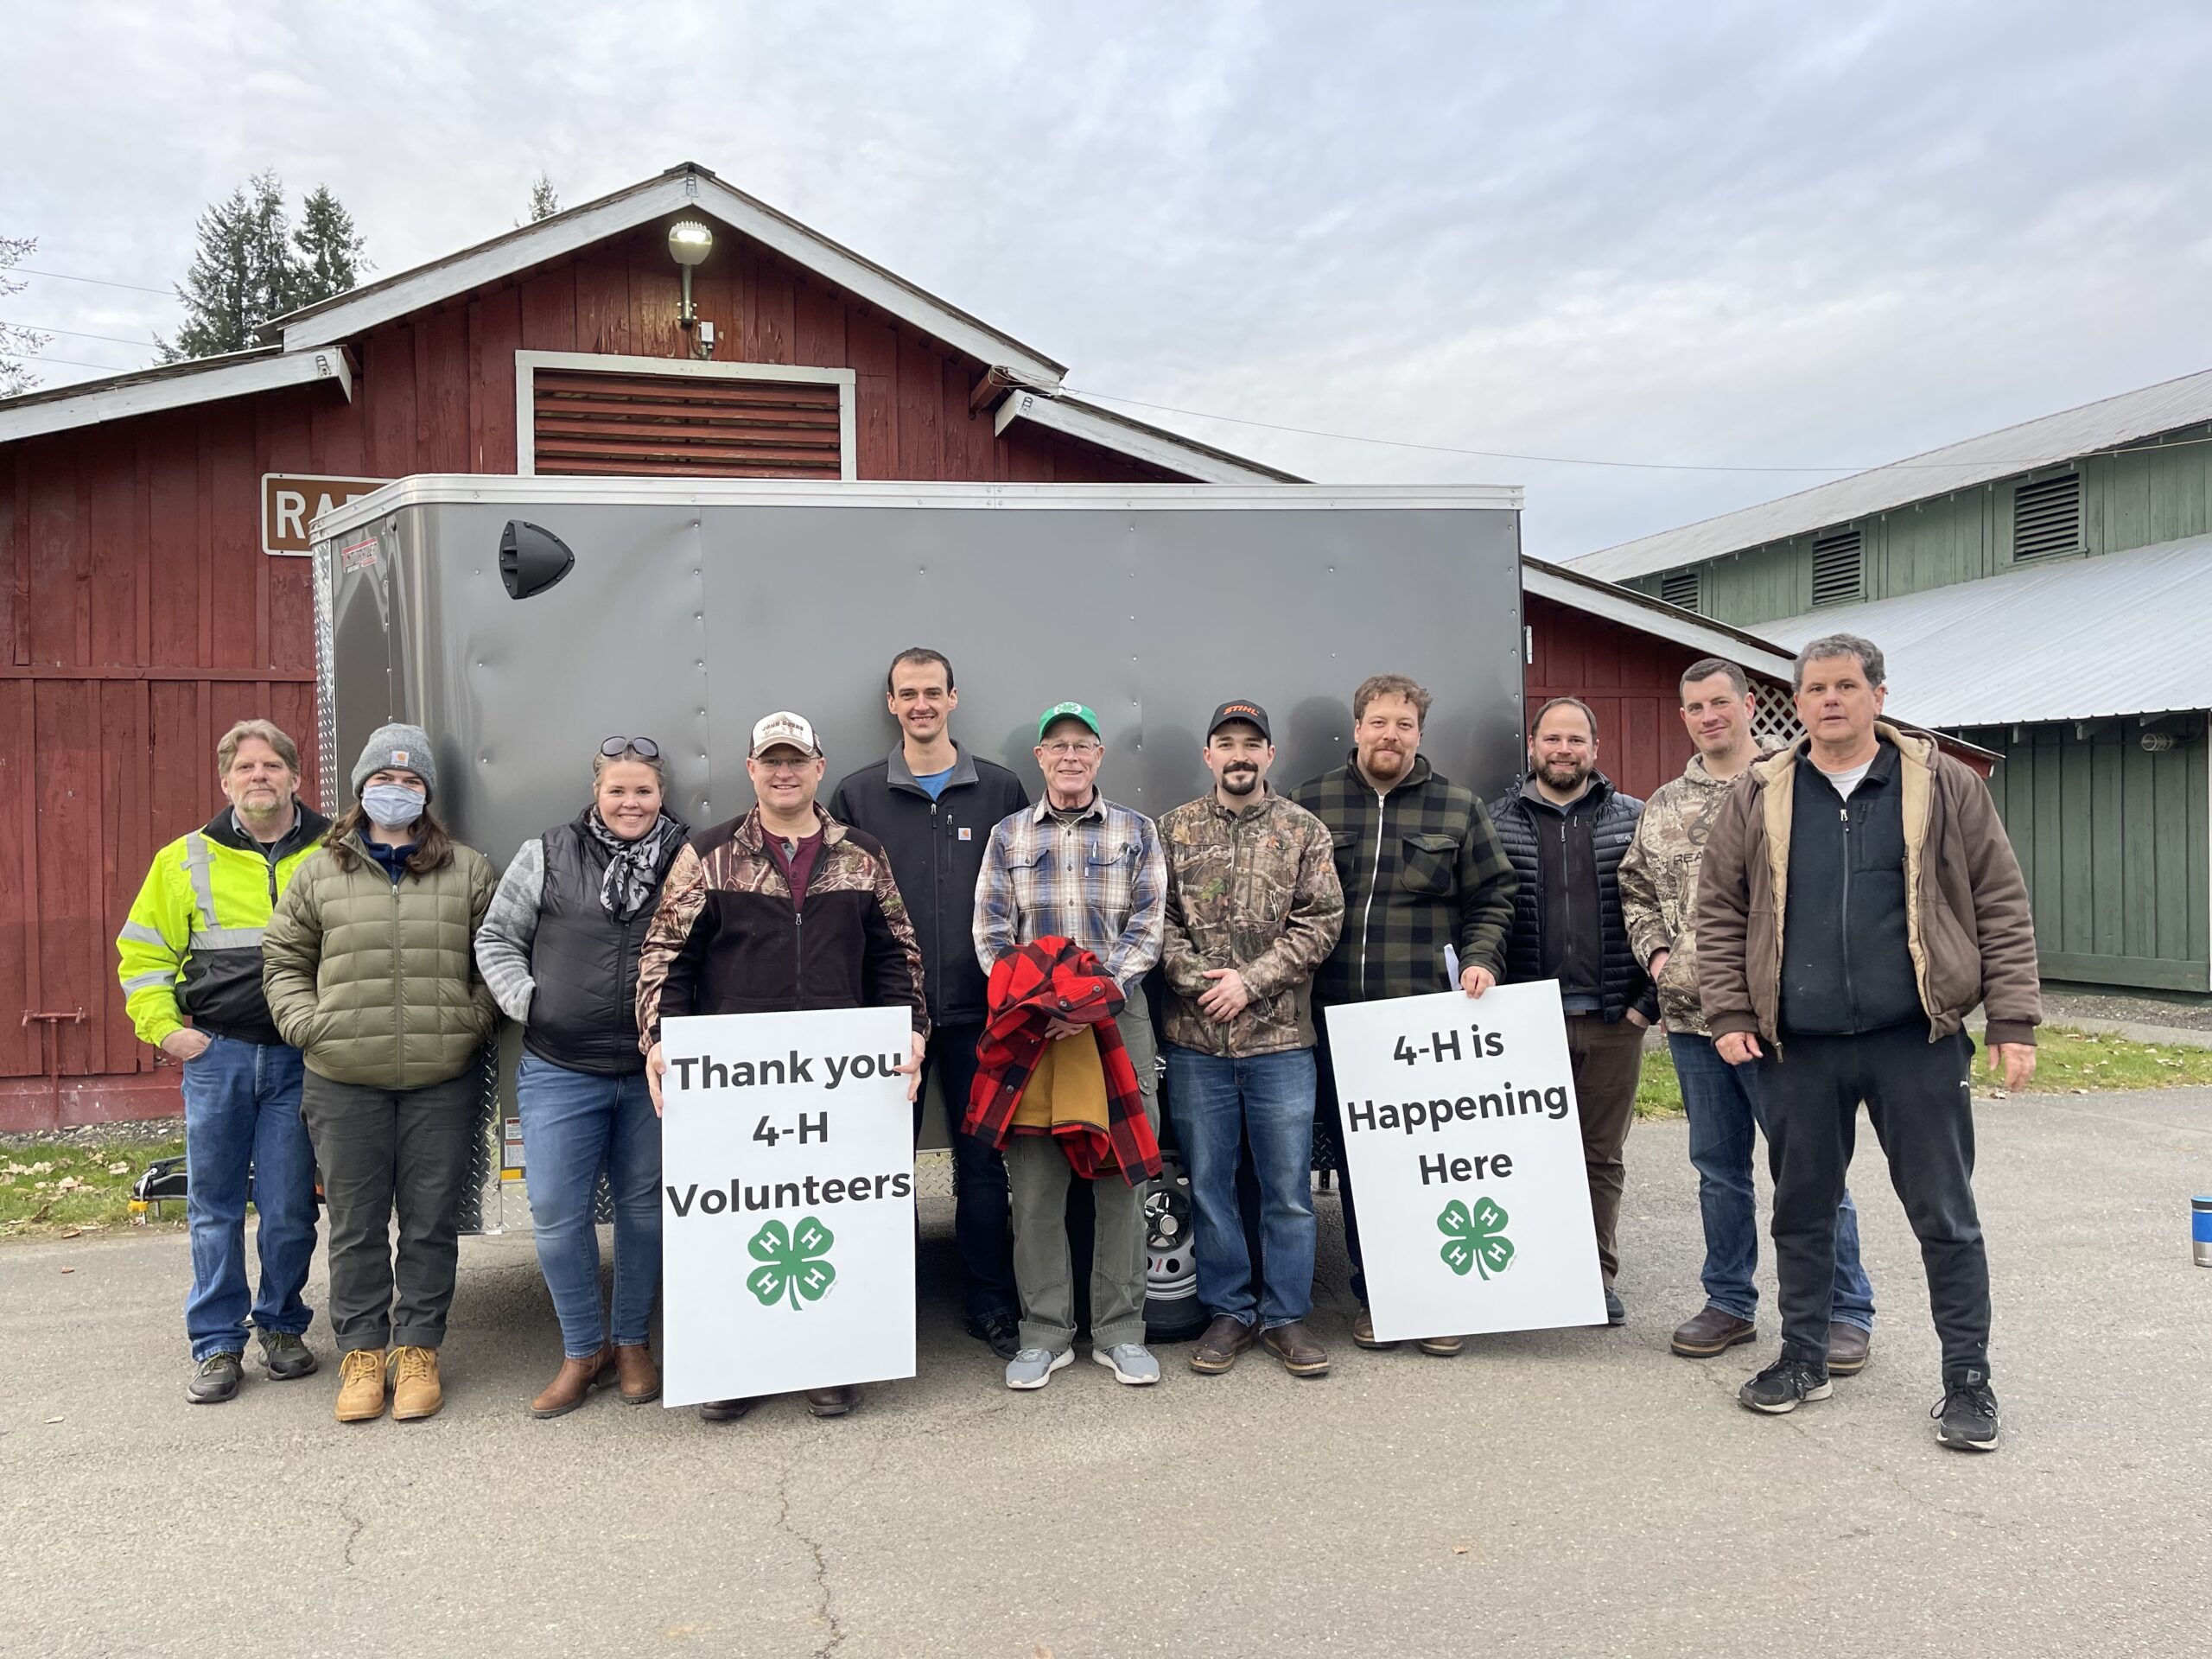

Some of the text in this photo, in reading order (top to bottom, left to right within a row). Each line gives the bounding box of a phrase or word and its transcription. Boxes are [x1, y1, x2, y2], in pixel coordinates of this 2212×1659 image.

[1224, 704, 1258, 716] STIHL
[1393, 1023, 1504, 1066] 4-H is
[671, 1050, 902, 1090] Thank you
[1347, 1081, 1569, 1135] Happening
[753, 1111, 828, 1147] 4-H
[1419, 1153, 1514, 1185] Here
[665, 1173, 911, 1217] Volunteers
[1445, 1210, 1465, 1230] H
[1479, 1206, 1499, 1227] H
[759, 1230, 782, 1255] H
[800, 1227, 823, 1250] H
[1448, 1246, 1468, 1266] H
[1487, 1243, 1507, 1262] H
[756, 1272, 779, 1295] H
[804, 1268, 826, 1290] H
